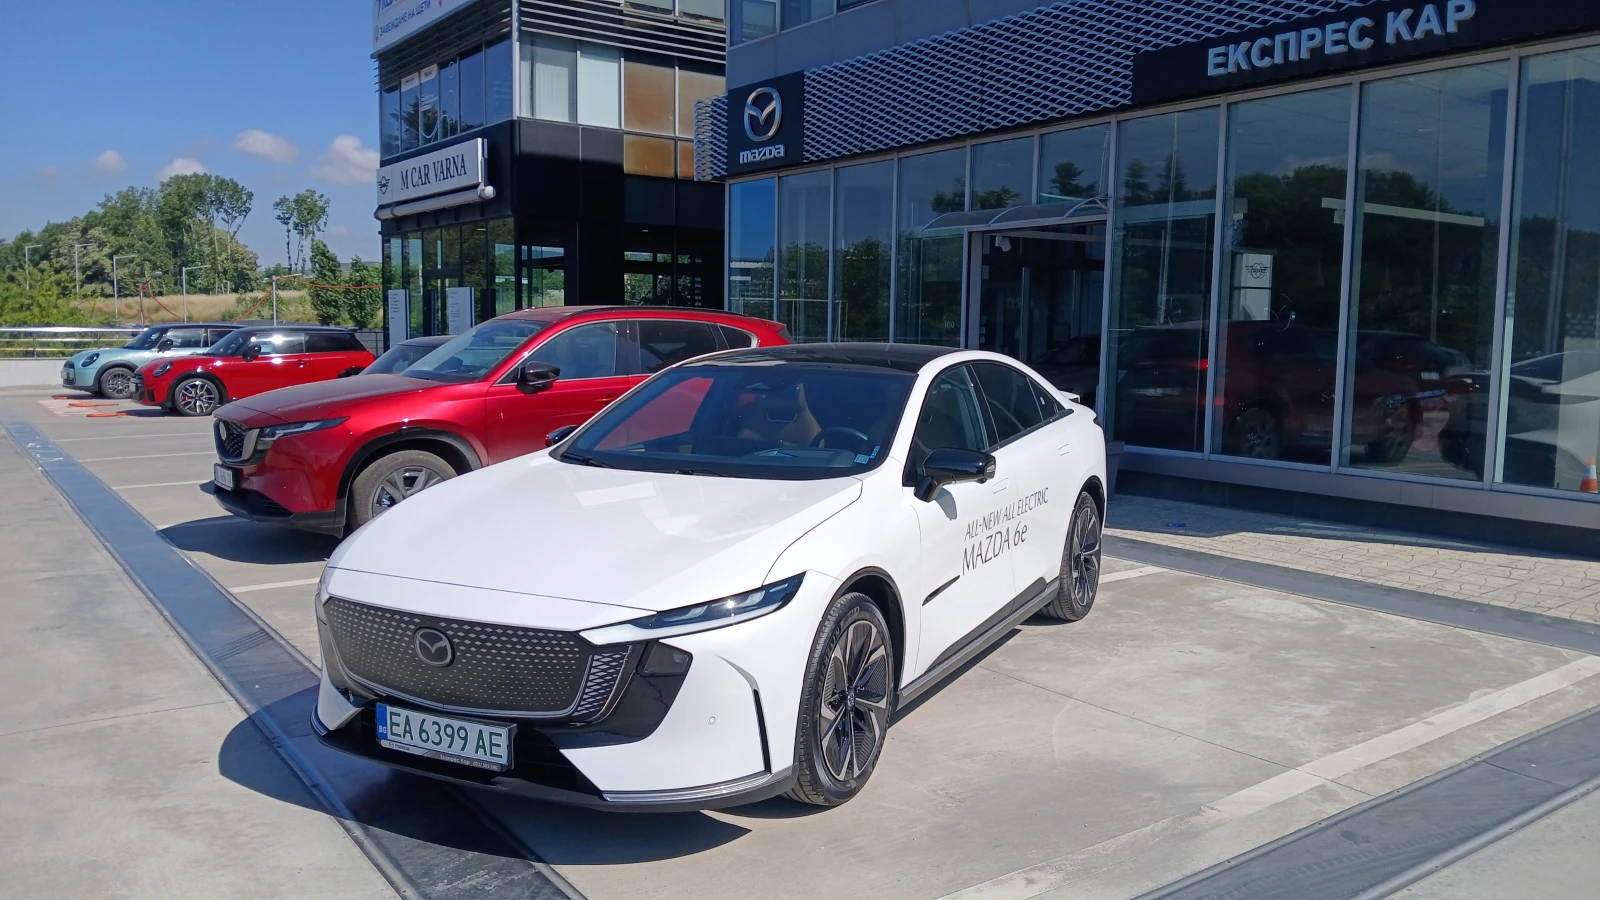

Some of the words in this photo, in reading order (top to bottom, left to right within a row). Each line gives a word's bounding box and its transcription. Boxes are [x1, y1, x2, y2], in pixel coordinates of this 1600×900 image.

[407, 8, 416, 19] НА
[1208, 17, 1375, 76] ЕКСПРЕС
[1385, 0, 1477, 44] КАР
[401, 169, 410, 190] M
[411, 164, 431, 188] CAR
[432, 154, 467, 182] VARNA
[740, 144, 785, 164] mazda
[964, 508, 1002, 542] ALL-NEW
[1002, 503, 1015, 524] ALL
[1017, 487, 1049, 517] ELECTRIC
[962, 526, 1010, 576] MAZDA
[1013, 520, 1028, 547] 6e
[378, 724, 388, 734] BG
[390, 711, 414, 741] EA
[418, 718, 469, 752] 6399
[475, 729, 503, 759] AE
